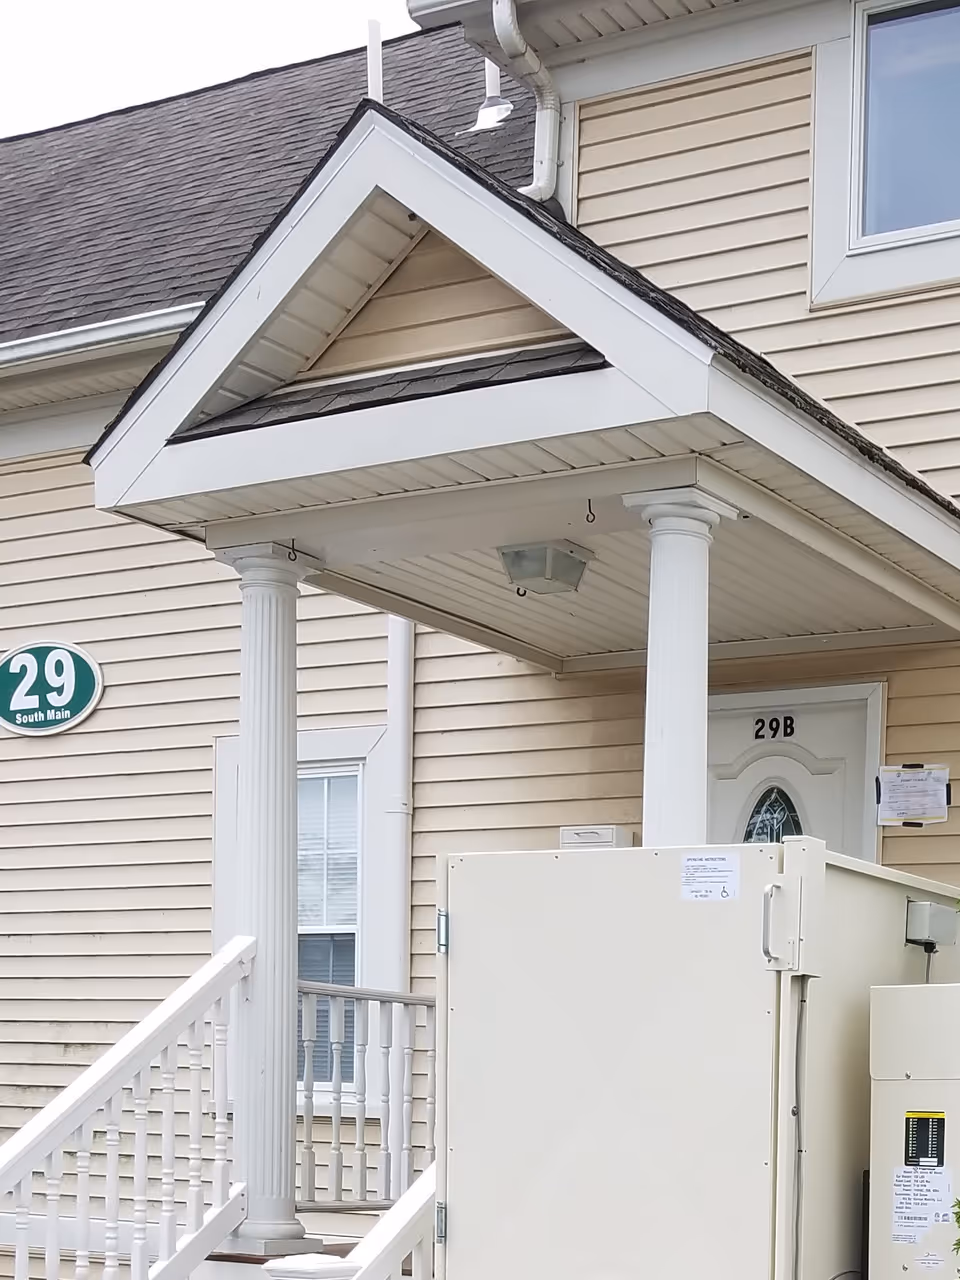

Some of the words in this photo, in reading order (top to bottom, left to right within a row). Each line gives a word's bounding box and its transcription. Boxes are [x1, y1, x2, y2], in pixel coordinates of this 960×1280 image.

[9, 648, 76, 711] 29
[15, 710, 45, 724] South
[46, 708, 71, 721] Main
[754, 715, 795, 740] 29B
